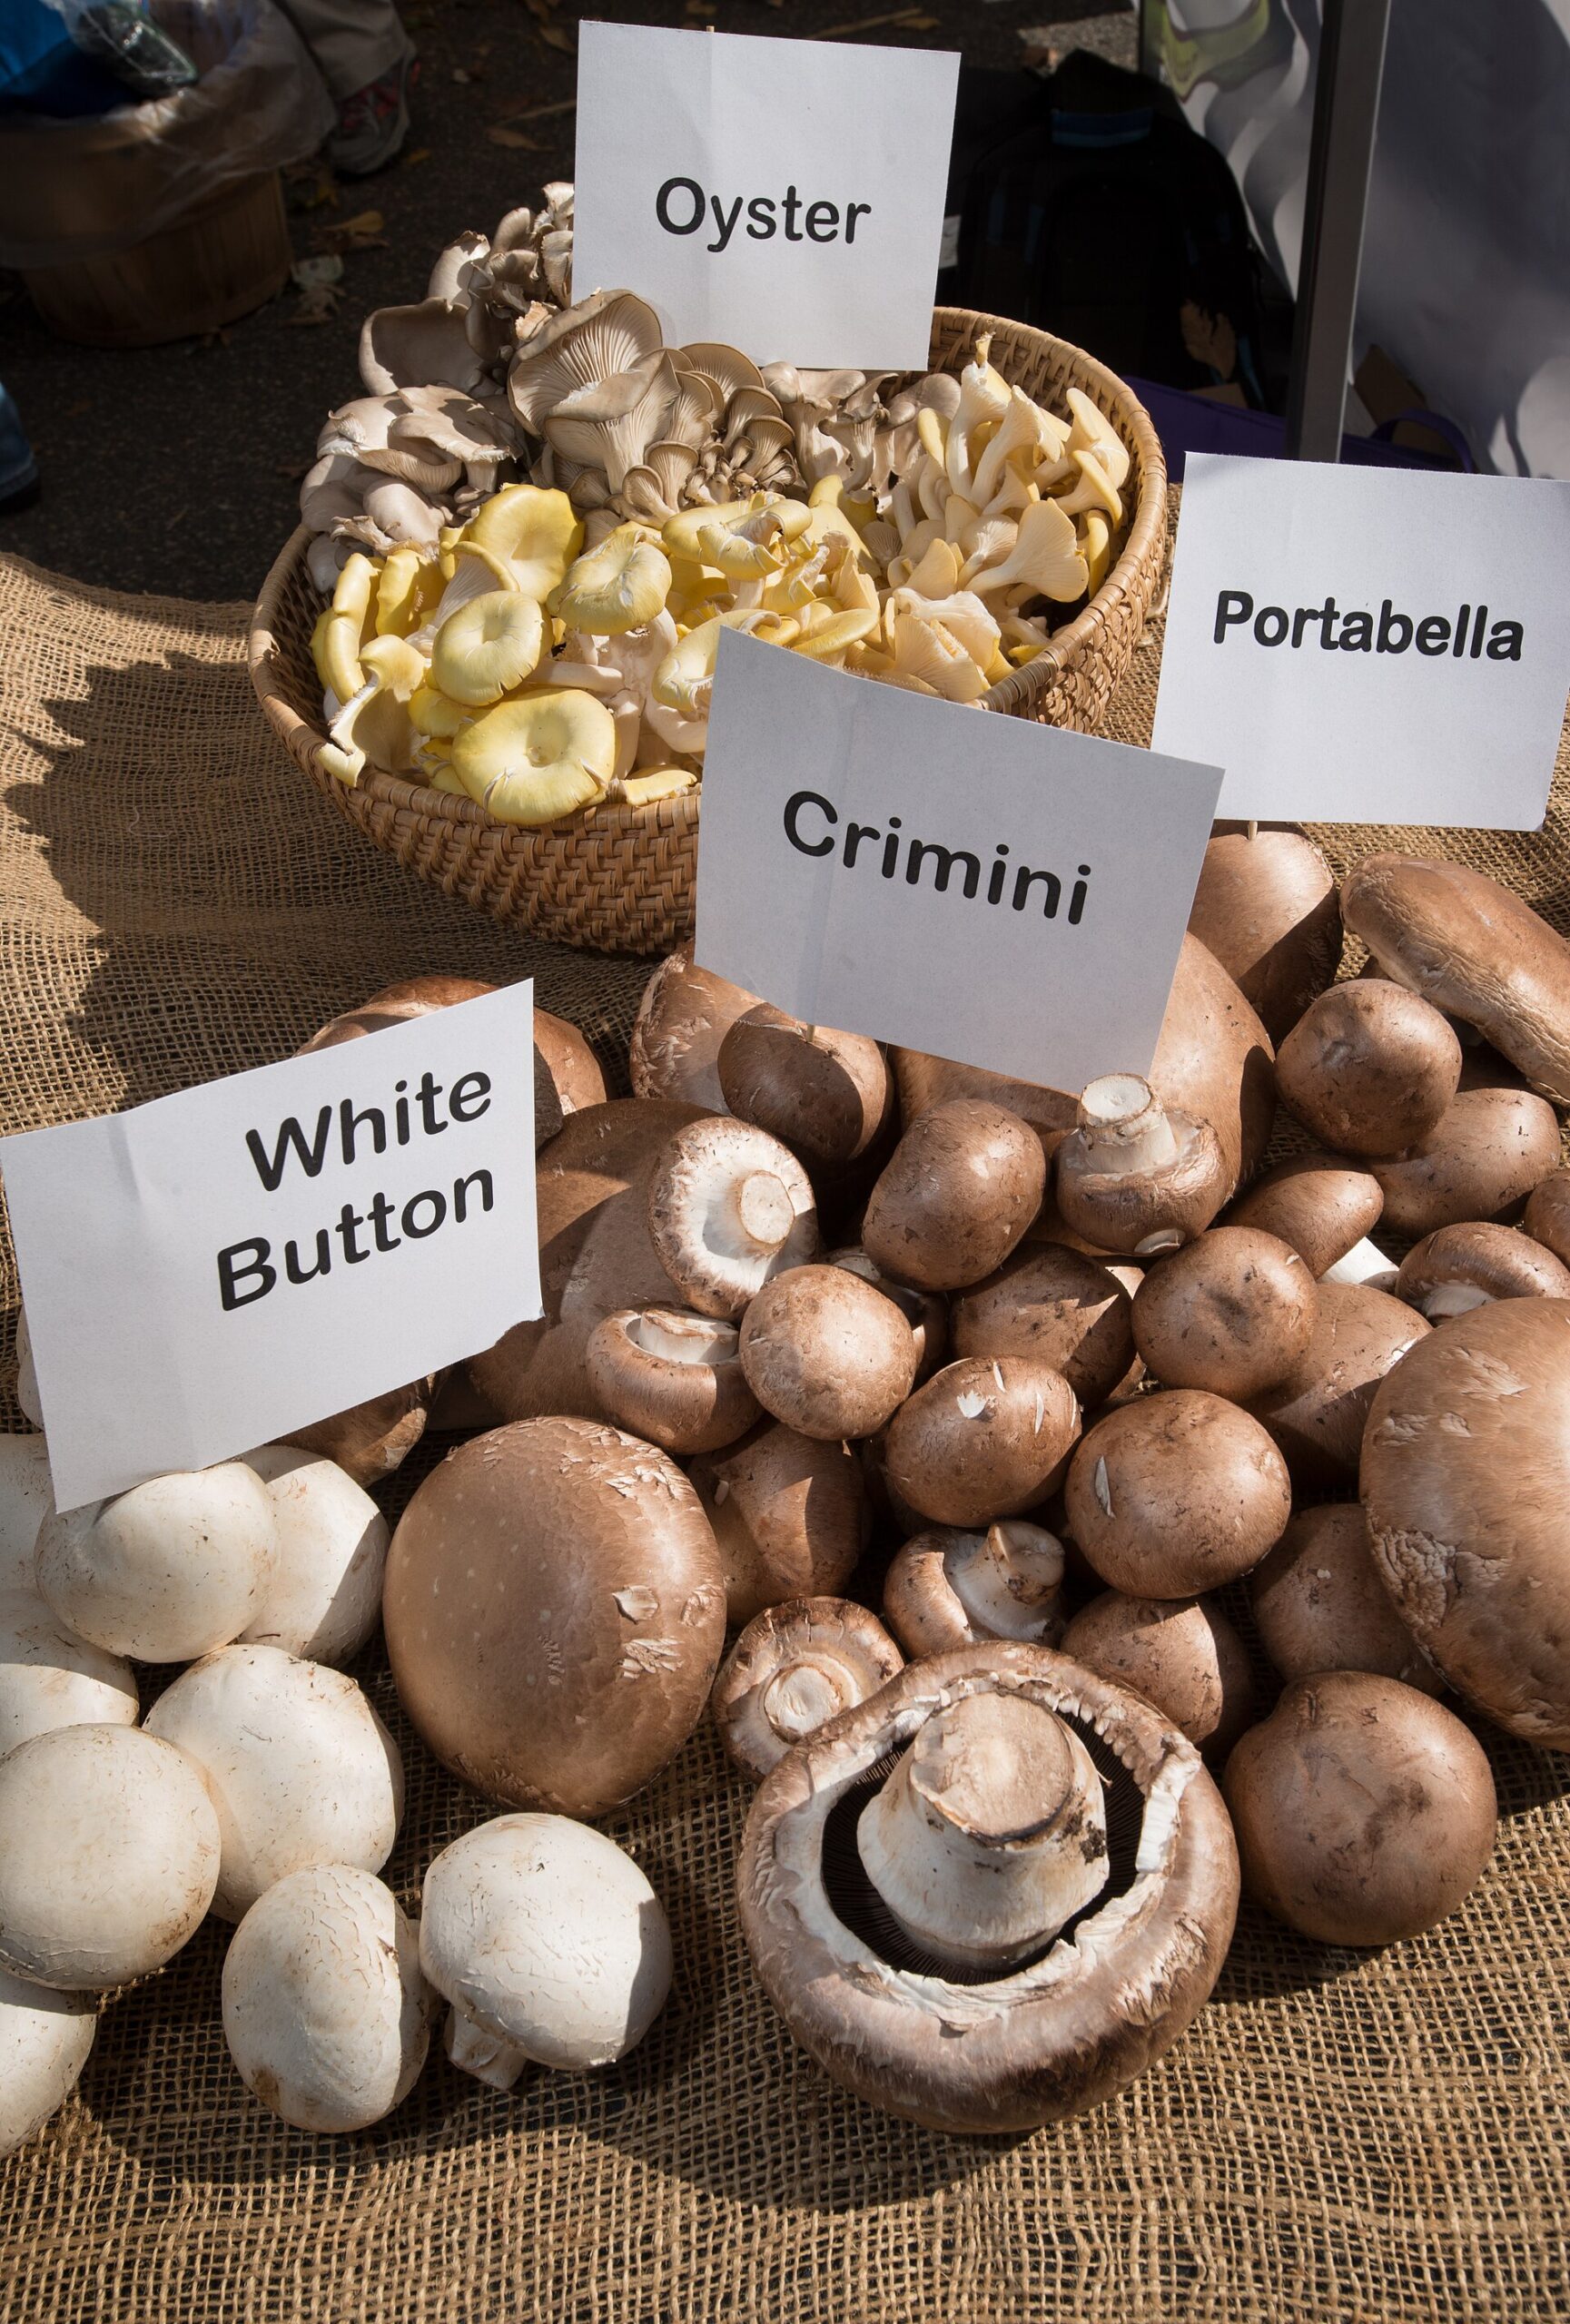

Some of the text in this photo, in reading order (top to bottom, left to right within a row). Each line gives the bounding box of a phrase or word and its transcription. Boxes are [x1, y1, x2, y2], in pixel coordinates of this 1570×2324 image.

[656, 177, 872, 253] Oyster
[1213, 590, 1524, 662] Portabella
[783, 790, 1092, 926] Crimini
[245, 1071, 491, 1192] White
[217, 1169, 494, 1312] Button
